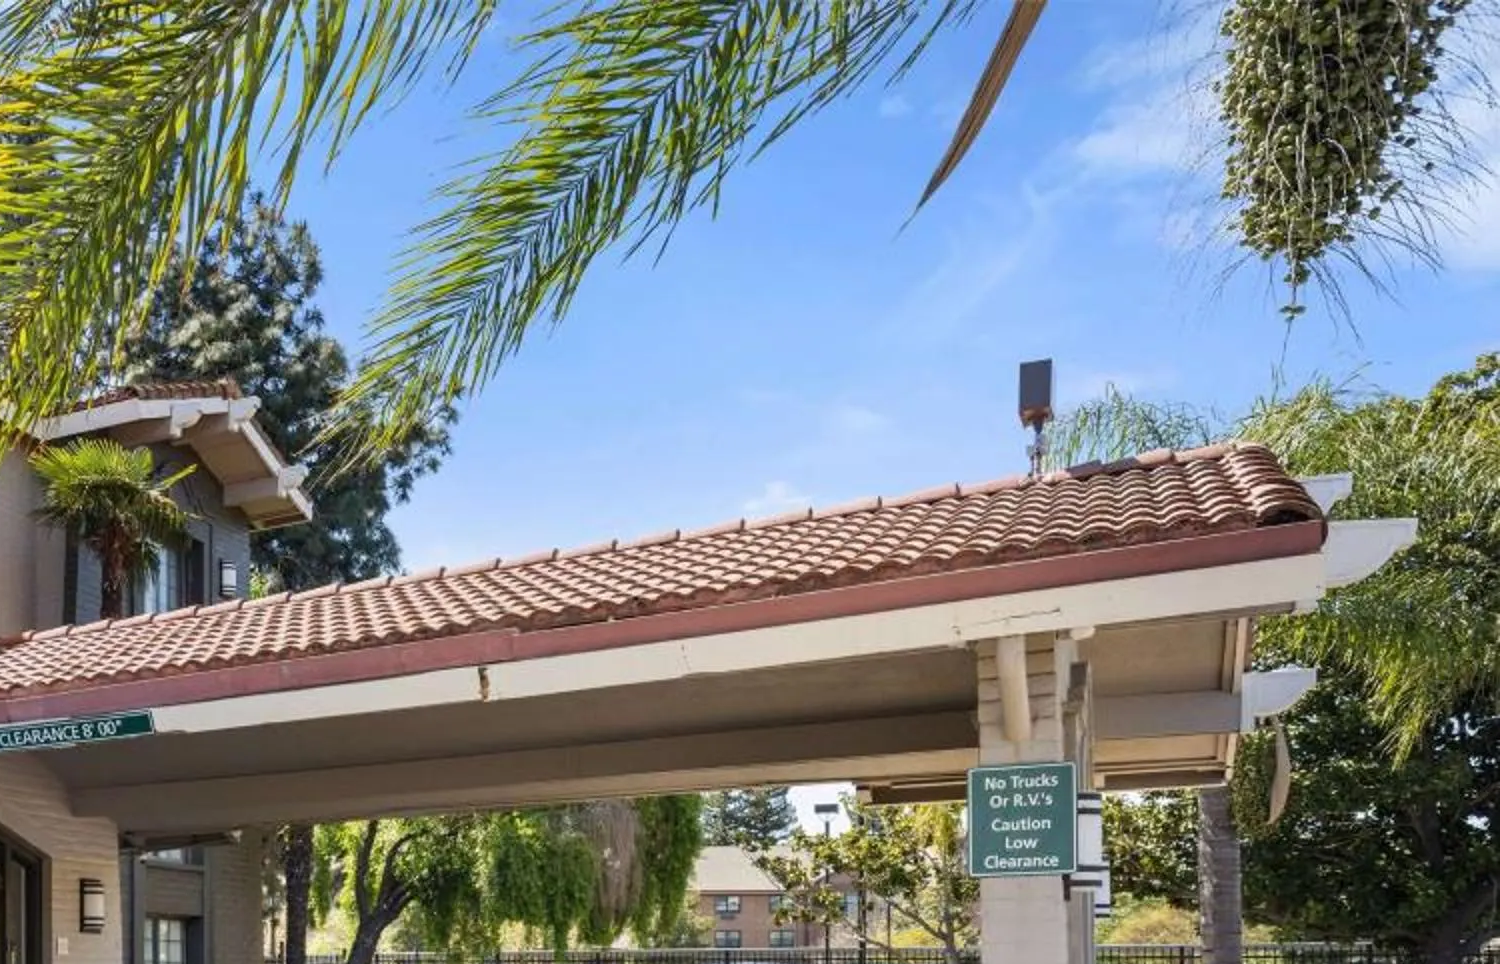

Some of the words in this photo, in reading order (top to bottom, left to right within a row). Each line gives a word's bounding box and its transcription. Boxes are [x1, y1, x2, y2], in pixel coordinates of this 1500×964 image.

[0, 724, 81, 747] CLEARANCE
[984, 777, 1007, 791] No
[1010, 774, 1059, 789] Trucks
[989, 795, 1009, 809] Or
[1013, 793, 1053, 807] R.V.'s
[991, 817, 1052, 832] Caution
[1005, 836, 1039, 849] Low
[984, 855, 1060, 869] Clearance
